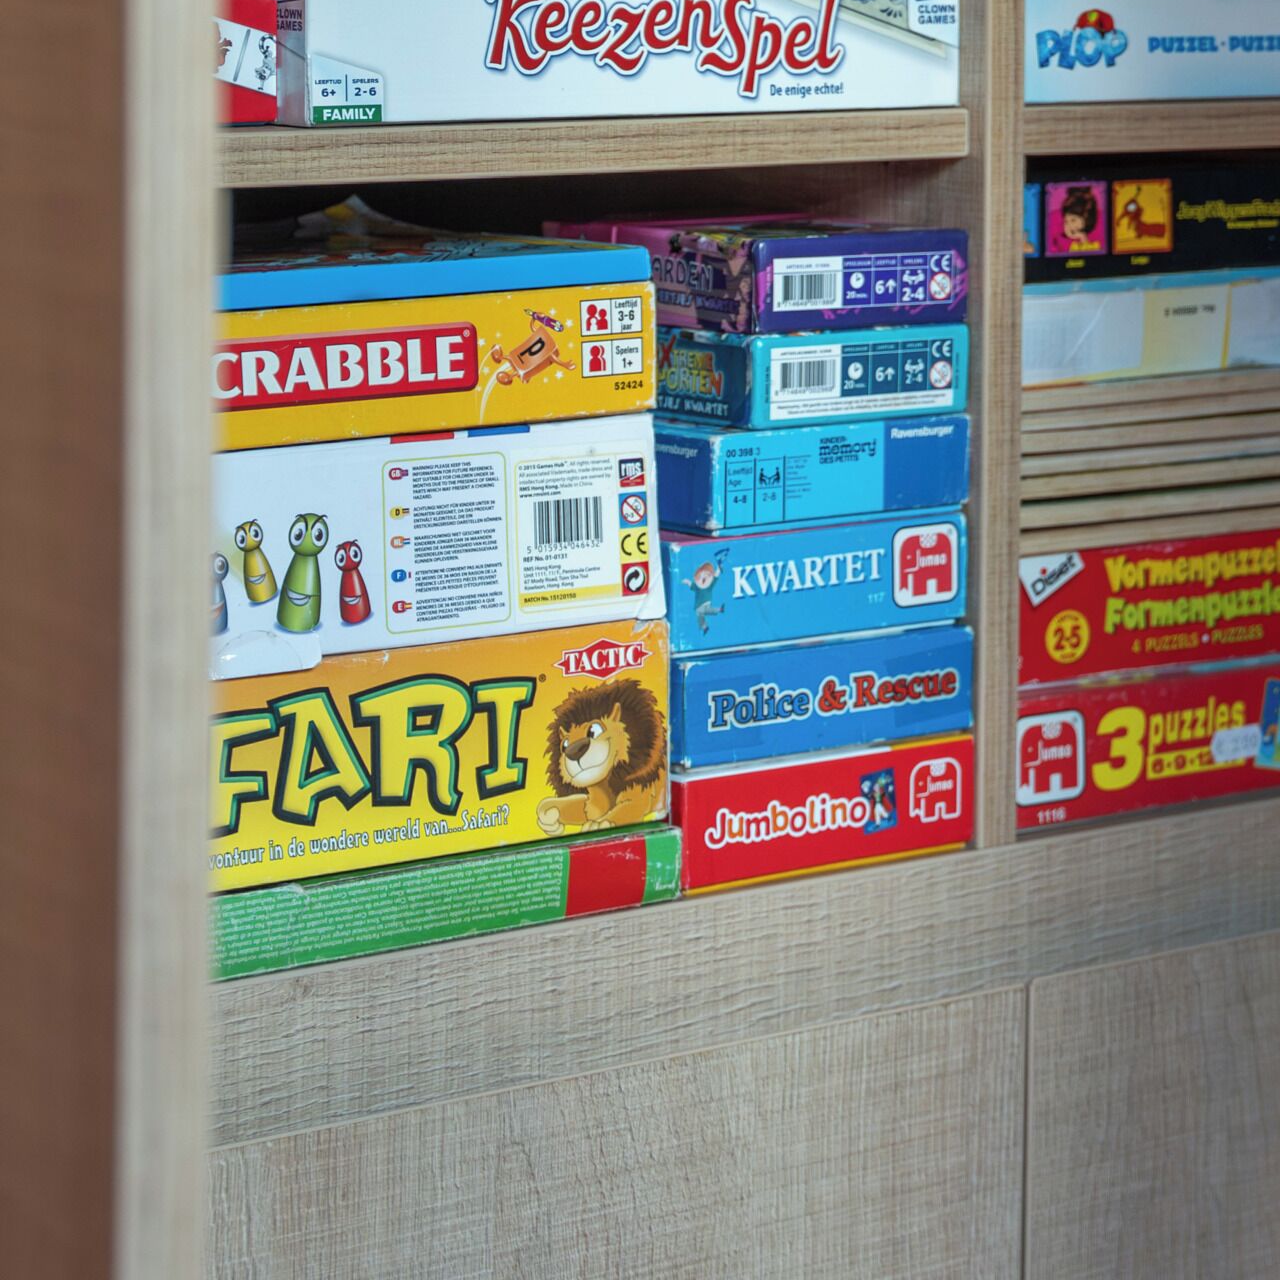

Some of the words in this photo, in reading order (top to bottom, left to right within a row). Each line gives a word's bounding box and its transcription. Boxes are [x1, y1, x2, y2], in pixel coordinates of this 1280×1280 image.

[917, 4, 956, 15] CLOWN
[917, 14, 956, 25] GAMES
[1035, 27, 1128, 71] PLOP
[1148, 36, 1219, 55] PUZZEL
[352, 77, 379, 85] SPELERS
[769, 83, 783, 97] De
[785, 83, 813, 98] enige
[814, 81, 844, 96] echte!
[321, 86, 337, 98] 6+
[322, 107, 376, 121] FAMILY
[875, 279, 885, 294] 6
[902, 287, 925, 301] 2-4
[614, 298, 639, 312] Leeftijd
[617, 309, 636, 323] 3-6
[620, 322, 634, 333] jaar
[520, 337, 546, 363] P
[615, 345, 639, 358] Spelers
[622, 358, 634, 368] 1+
[875, 367, 885, 381] 6
[613, 380, 644, 391] 52424
[890, 424, 954, 440] Ravensburger
[819, 437, 877, 457] memory
[905, 549, 948, 574] Jumbo
[732, 547, 886, 599] KWARTET
[1031, 552, 1078, 596] Diset
[1053, 625, 1081, 651] 2-5
[1131, 639, 1141, 653] 4
[1145, 631, 1199, 652] PUZZELS
[561, 640, 645, 674] TACTIC
[709, 684, 811, 731] Police
[817, 678, 848, 714] &
[852, 669, 959, 710] Rescue
[1091, 705, 1146, 792] 3
[1149, 694, 1248, 755] puzzles
[208, 673, 538, 834] FARI
[1025, 740, 1074, 768] Jumbo
[915, 775, 954, 799] Jumbo
[704, 794, 870, 848] Jumbolino
[269, 843, 284, 860] in
[288, 840, 305, 858] de
[308, 831, 369, 856] wondere
[373, 818, 421, 847] wereld
